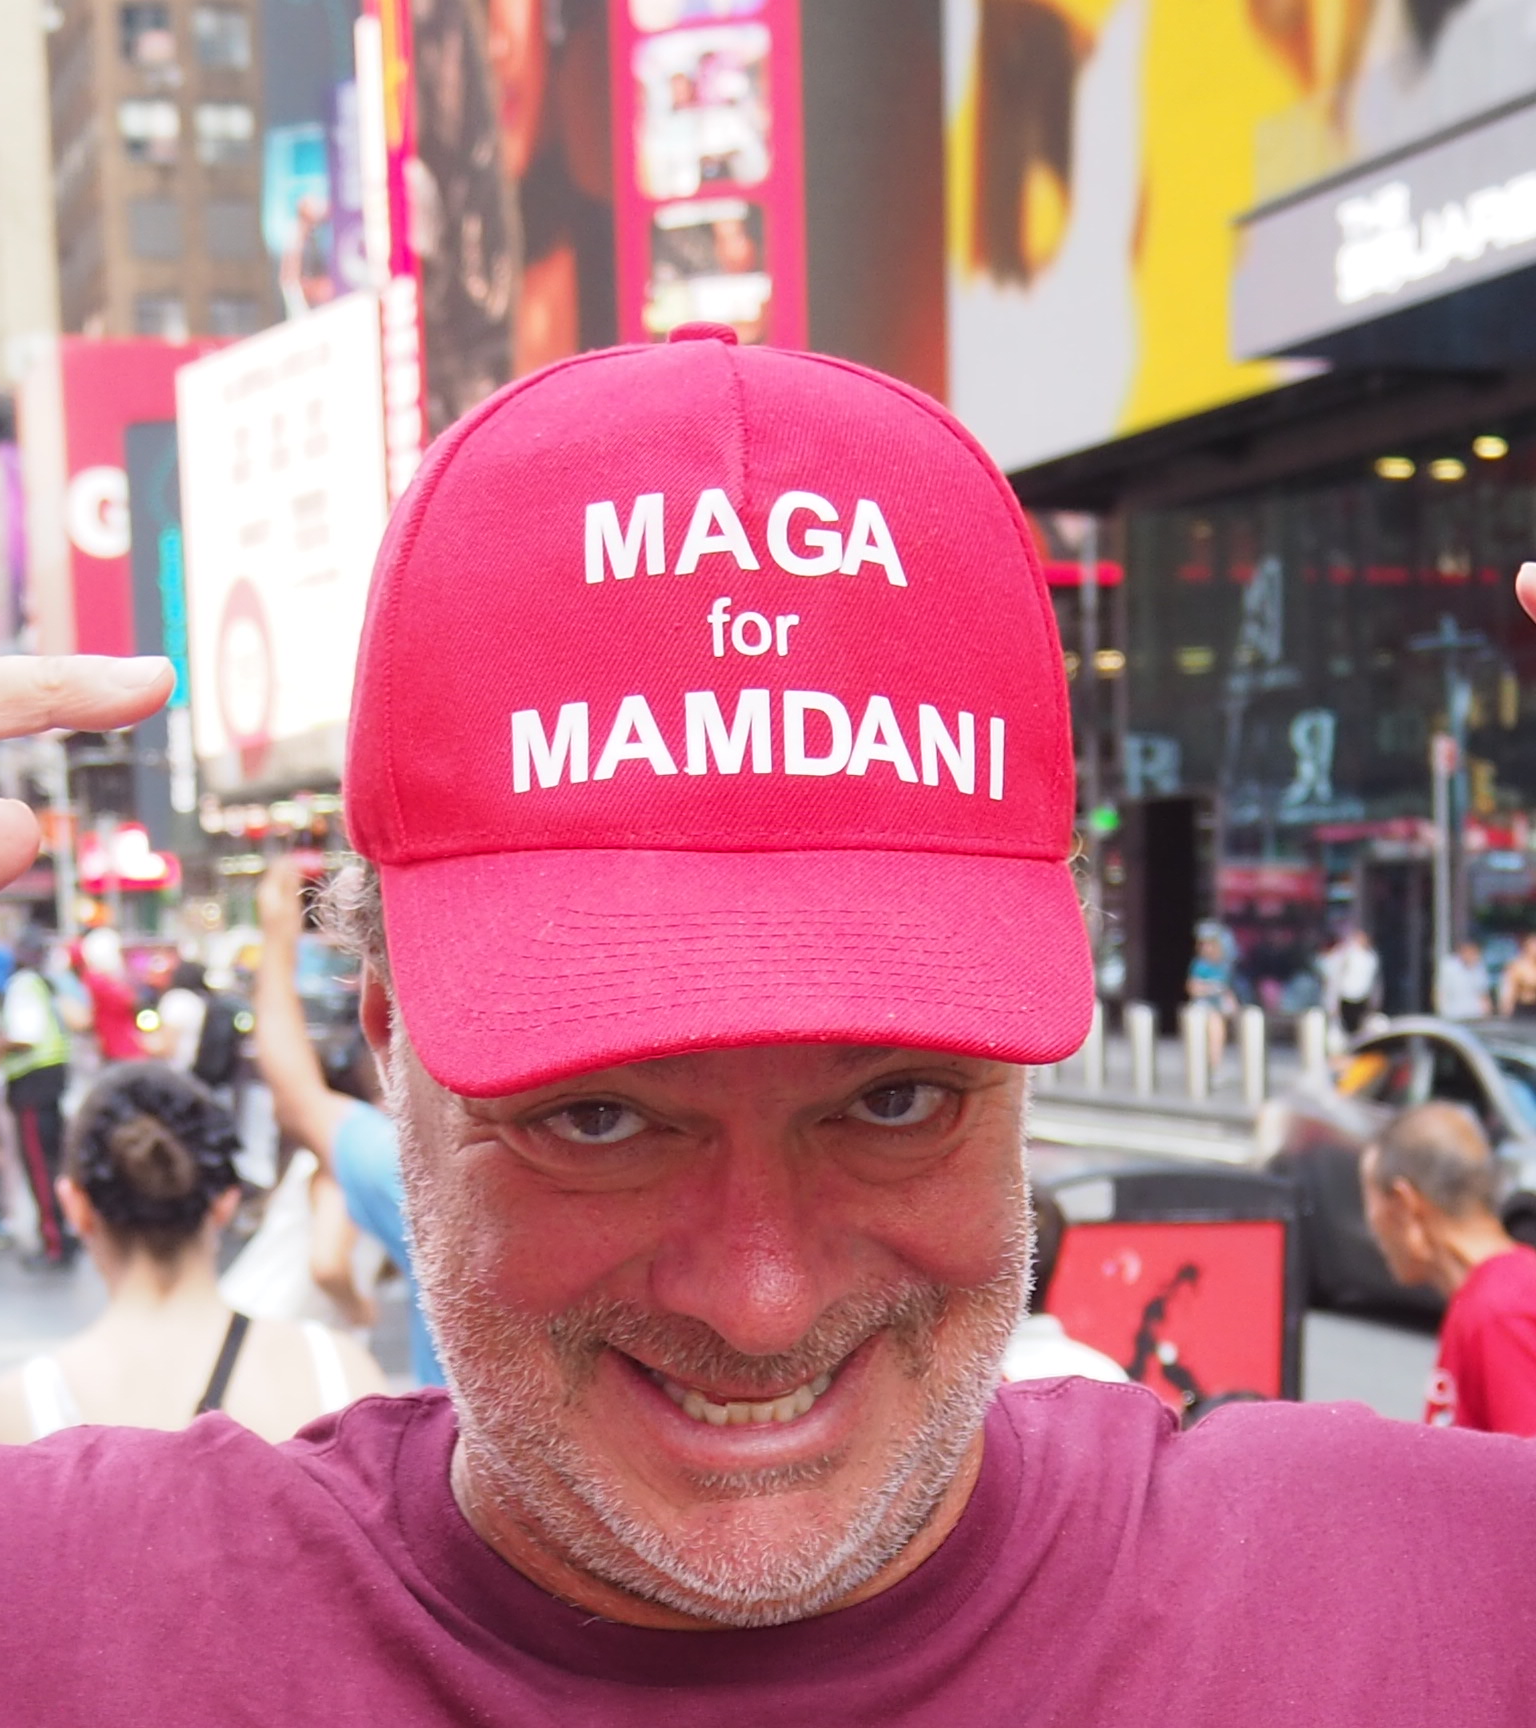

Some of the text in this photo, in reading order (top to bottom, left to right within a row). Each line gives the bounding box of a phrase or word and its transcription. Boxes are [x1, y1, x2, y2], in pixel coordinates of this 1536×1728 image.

[585, 488, 907, 587] MAGA
[707, 597, 799, 657] for
[511, 689, 1004, 800] MAMDANI
